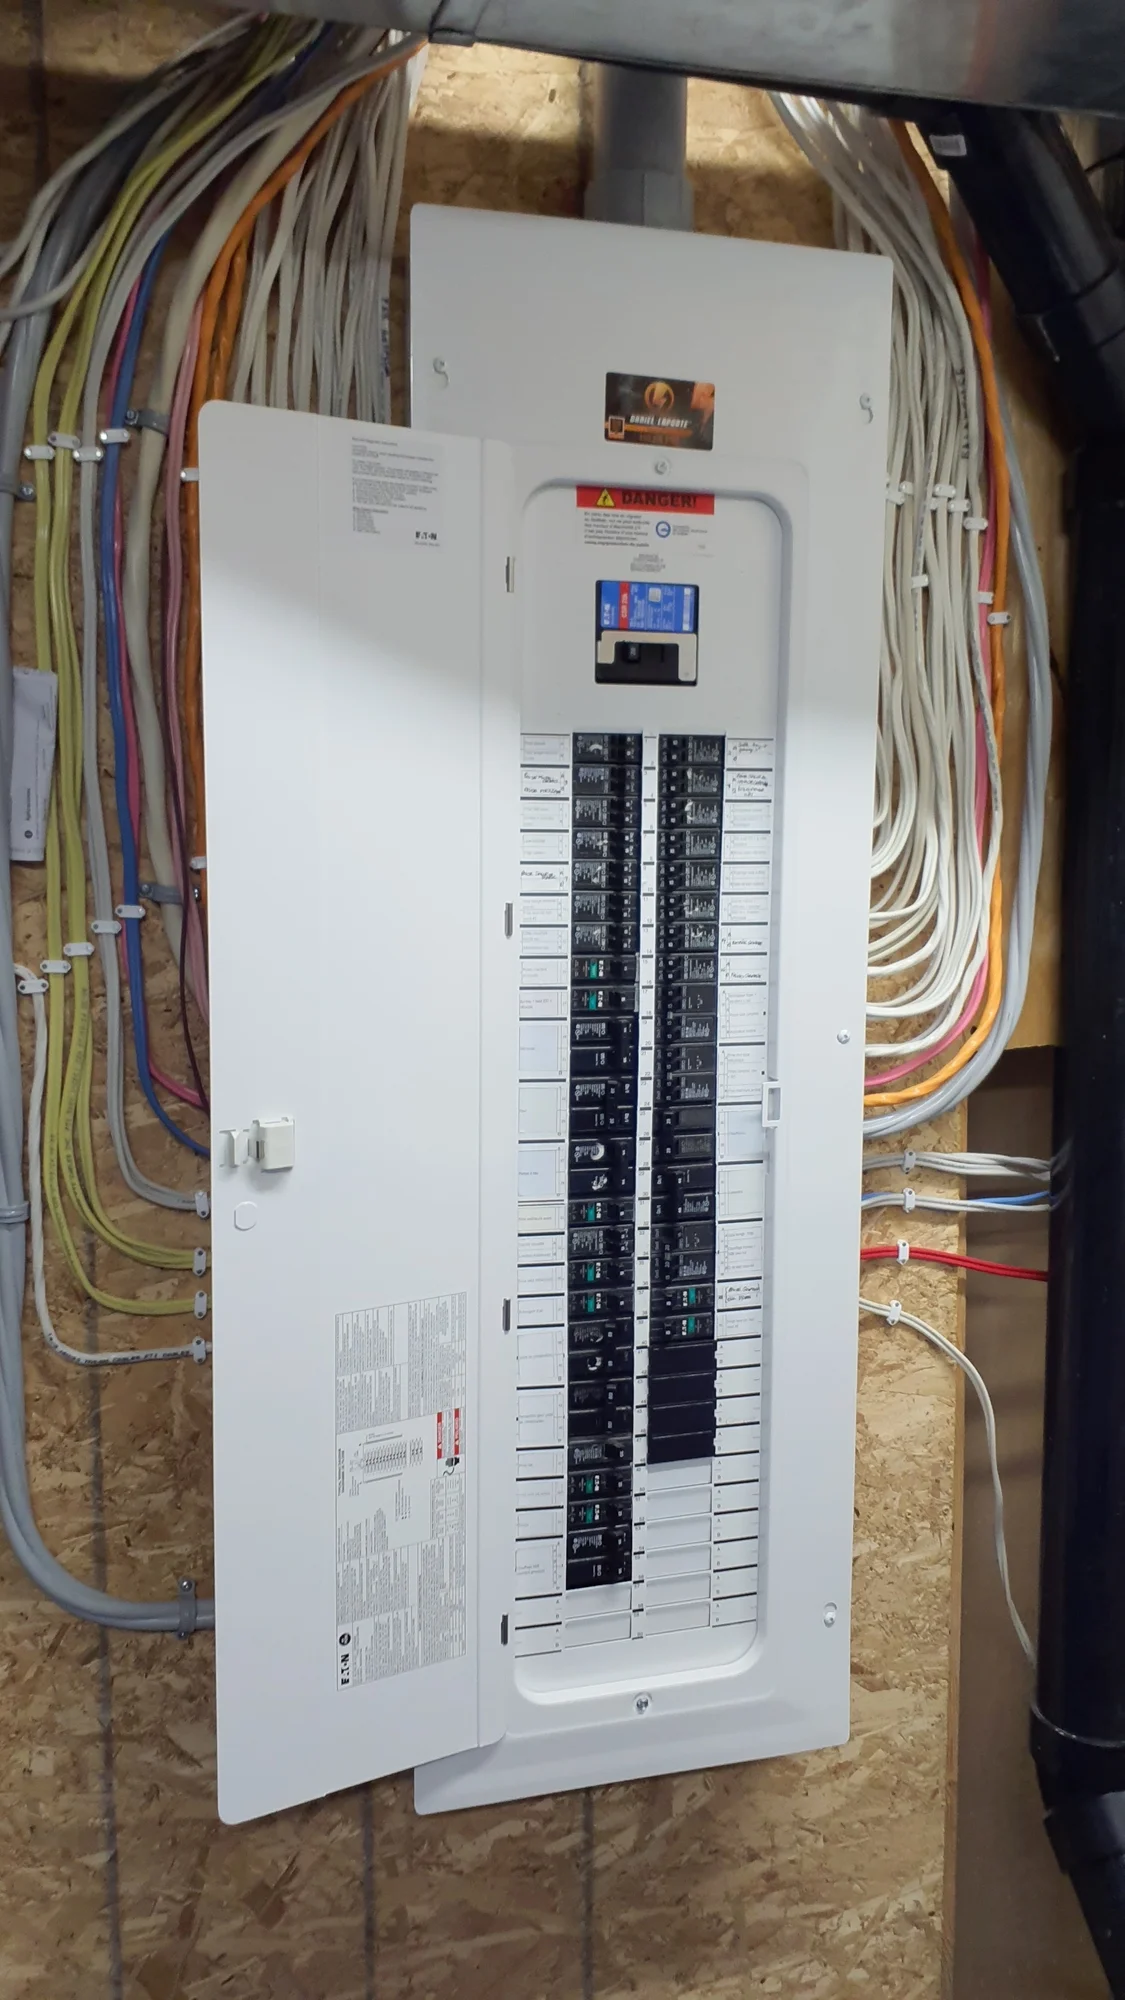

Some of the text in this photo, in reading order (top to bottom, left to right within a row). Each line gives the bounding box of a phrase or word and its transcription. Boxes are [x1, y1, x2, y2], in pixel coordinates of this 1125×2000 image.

[629, 415, 689, 429] DANIEL LAPORTE
[621, 490, 697, 508] DANGER!
